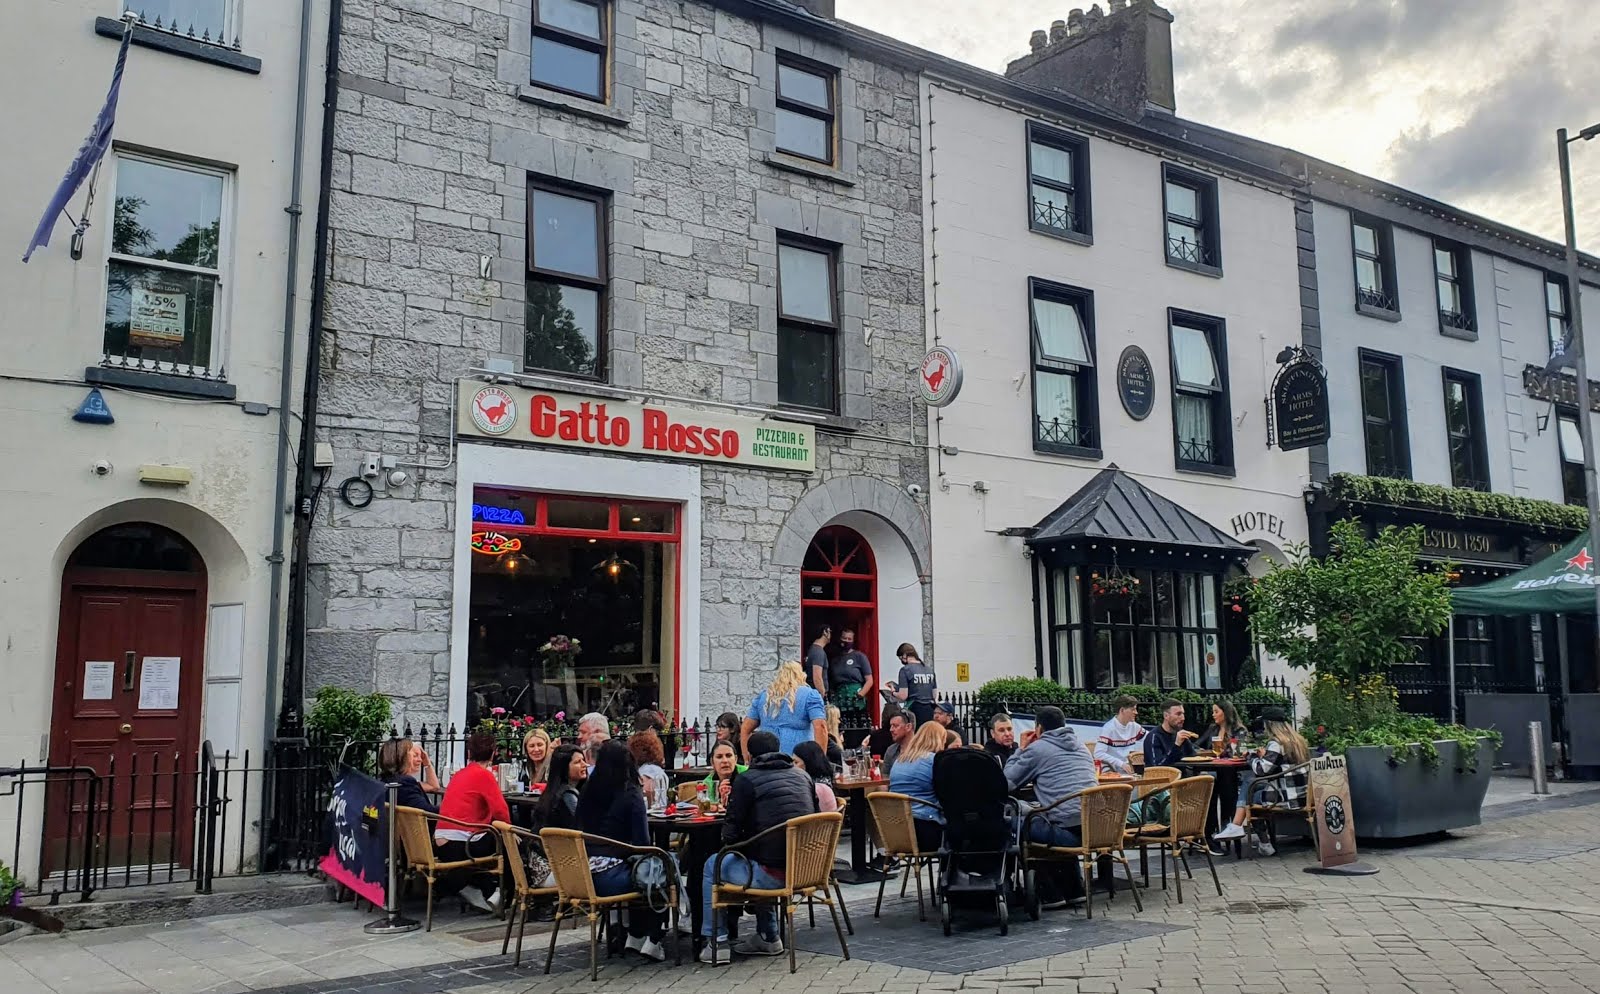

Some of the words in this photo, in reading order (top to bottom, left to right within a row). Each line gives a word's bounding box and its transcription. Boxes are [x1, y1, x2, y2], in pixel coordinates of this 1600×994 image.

[1127, 379, 1147, 388] HOTEL
[1292, 391, 1314, 401] ARMS
[84, 407, 108, 416] Chubb
[1289, 399, 1316, 411] HOTEL
[530, 394, 630, 447] Gatto
[643, 408, 740, 459] Rosso
[756, 427, 796, 445] PIZZERIA
[799, 433, 805, 446] &
[752, 443, 809, 461] RESTAURANT
[471, 504, 525, 524] PIZZA
[1231, 511, 1287, 541] HOTEL
[1464, 533, 1490, 553] 1850
[1512, 573, 1595, 590] Heinek
[1314, 756, 1344, 771] LAVAZZA
